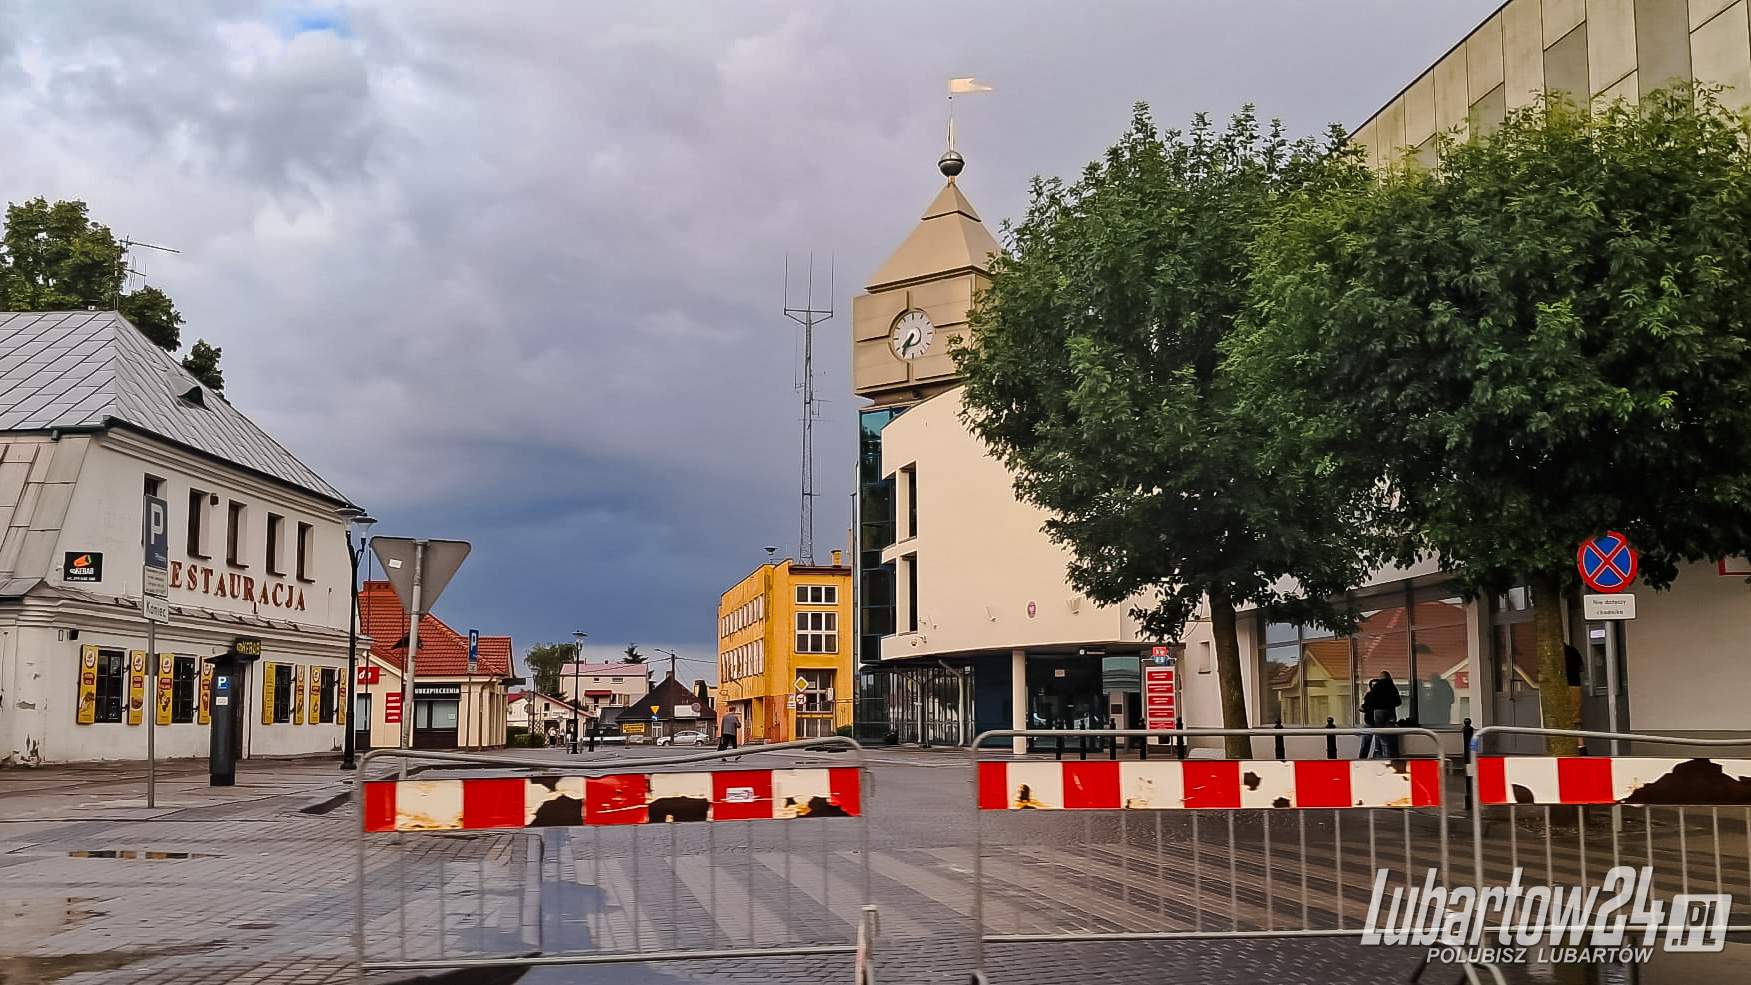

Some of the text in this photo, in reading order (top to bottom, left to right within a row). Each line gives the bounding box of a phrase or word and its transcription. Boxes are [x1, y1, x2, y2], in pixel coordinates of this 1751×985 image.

[150, 502, 164, 545] P
[168, 560, 306, 611] ESTAURACJA
[146, 599, 167, 618] Koniec
[470, 632, 477, 651] P
[217, 676, 227, 689] P
